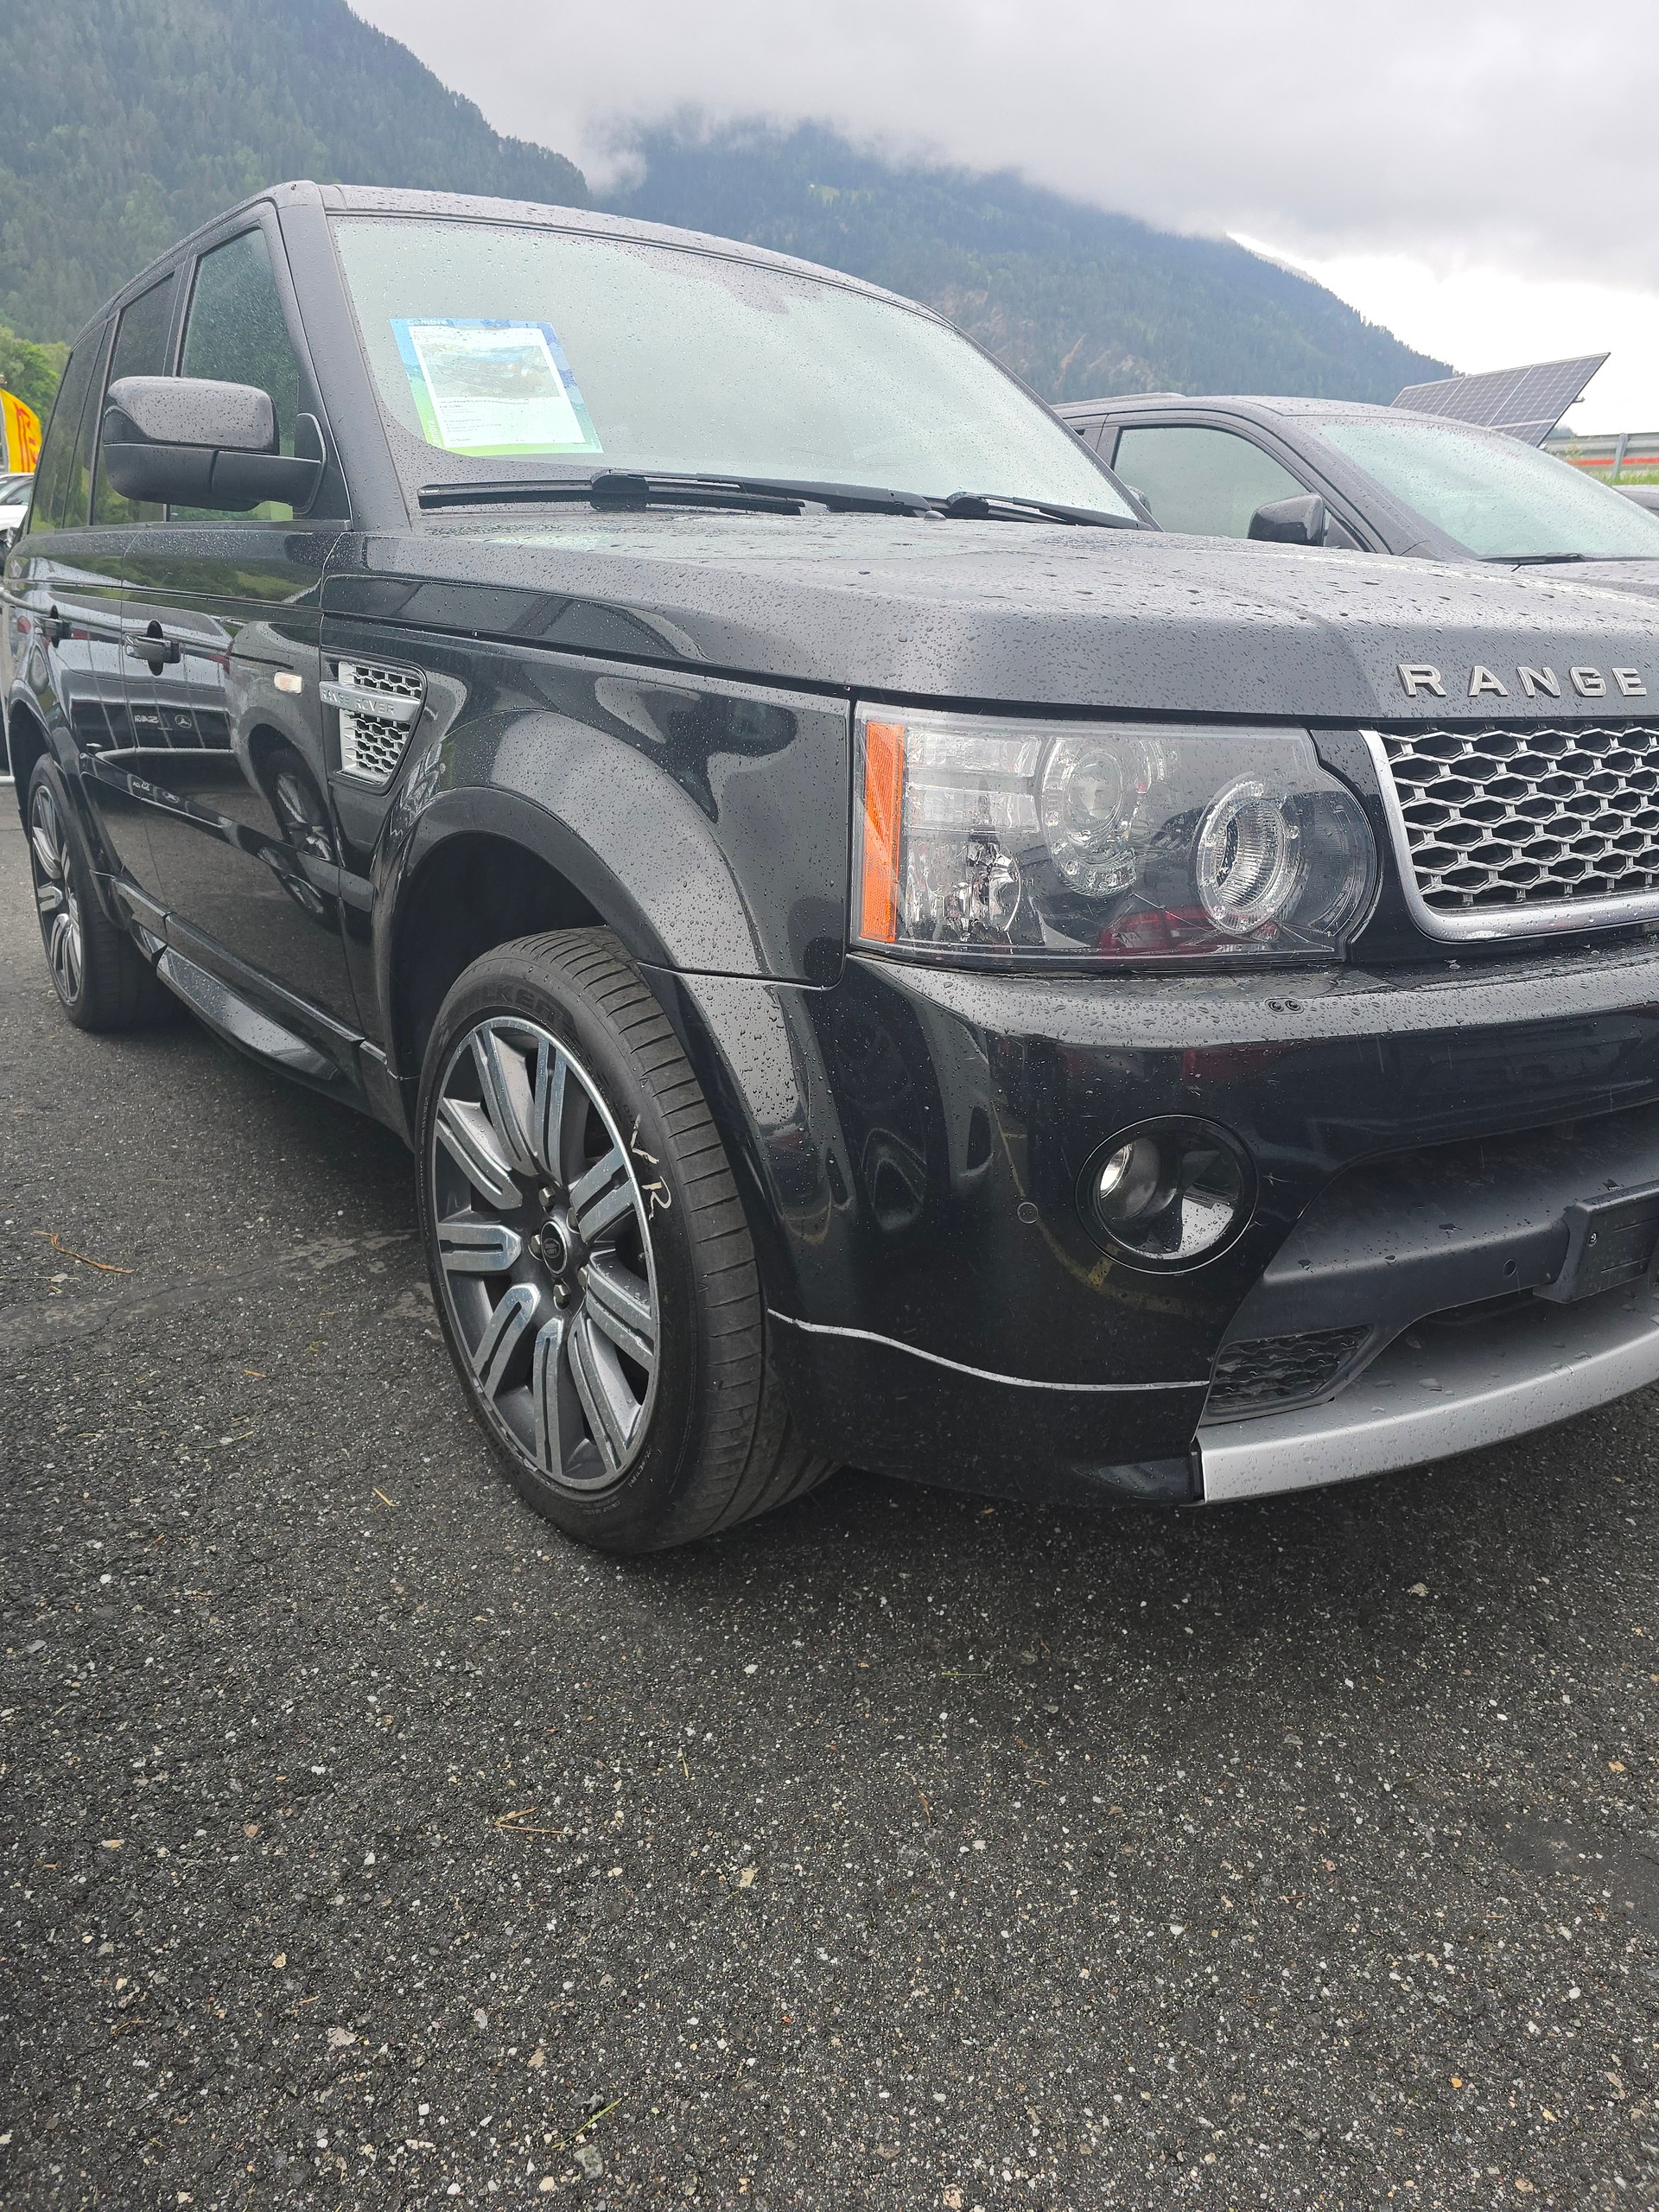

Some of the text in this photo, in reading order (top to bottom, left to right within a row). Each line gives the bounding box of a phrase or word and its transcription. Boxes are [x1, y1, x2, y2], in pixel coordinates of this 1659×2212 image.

[1396, 664, 1647, 697] RANGE
[321, 690, 395, 715] RANGE ROVER
